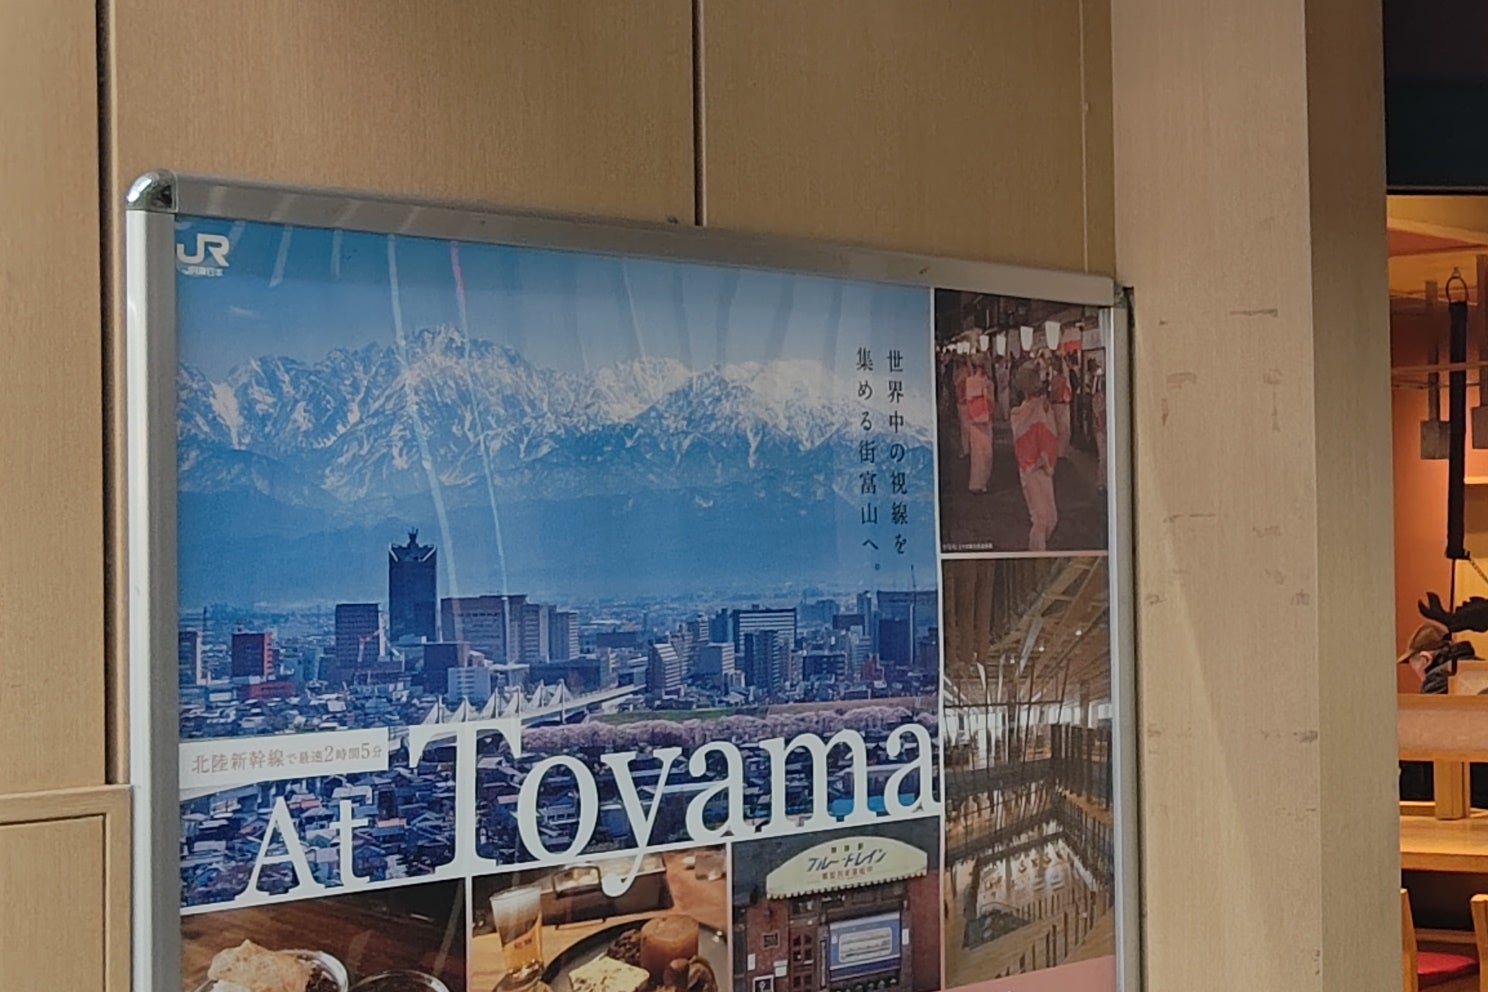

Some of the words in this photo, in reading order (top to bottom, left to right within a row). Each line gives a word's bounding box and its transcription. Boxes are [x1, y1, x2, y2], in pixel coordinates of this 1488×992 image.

[176, 233, 230, 267] JR
[855, 346, 881, 571] 集める街富山へ。
[886, 349, 909, 554] 世界中の視線を
[234, 796, 371, 900] At
[408, 718, 943, 897] Toyama
